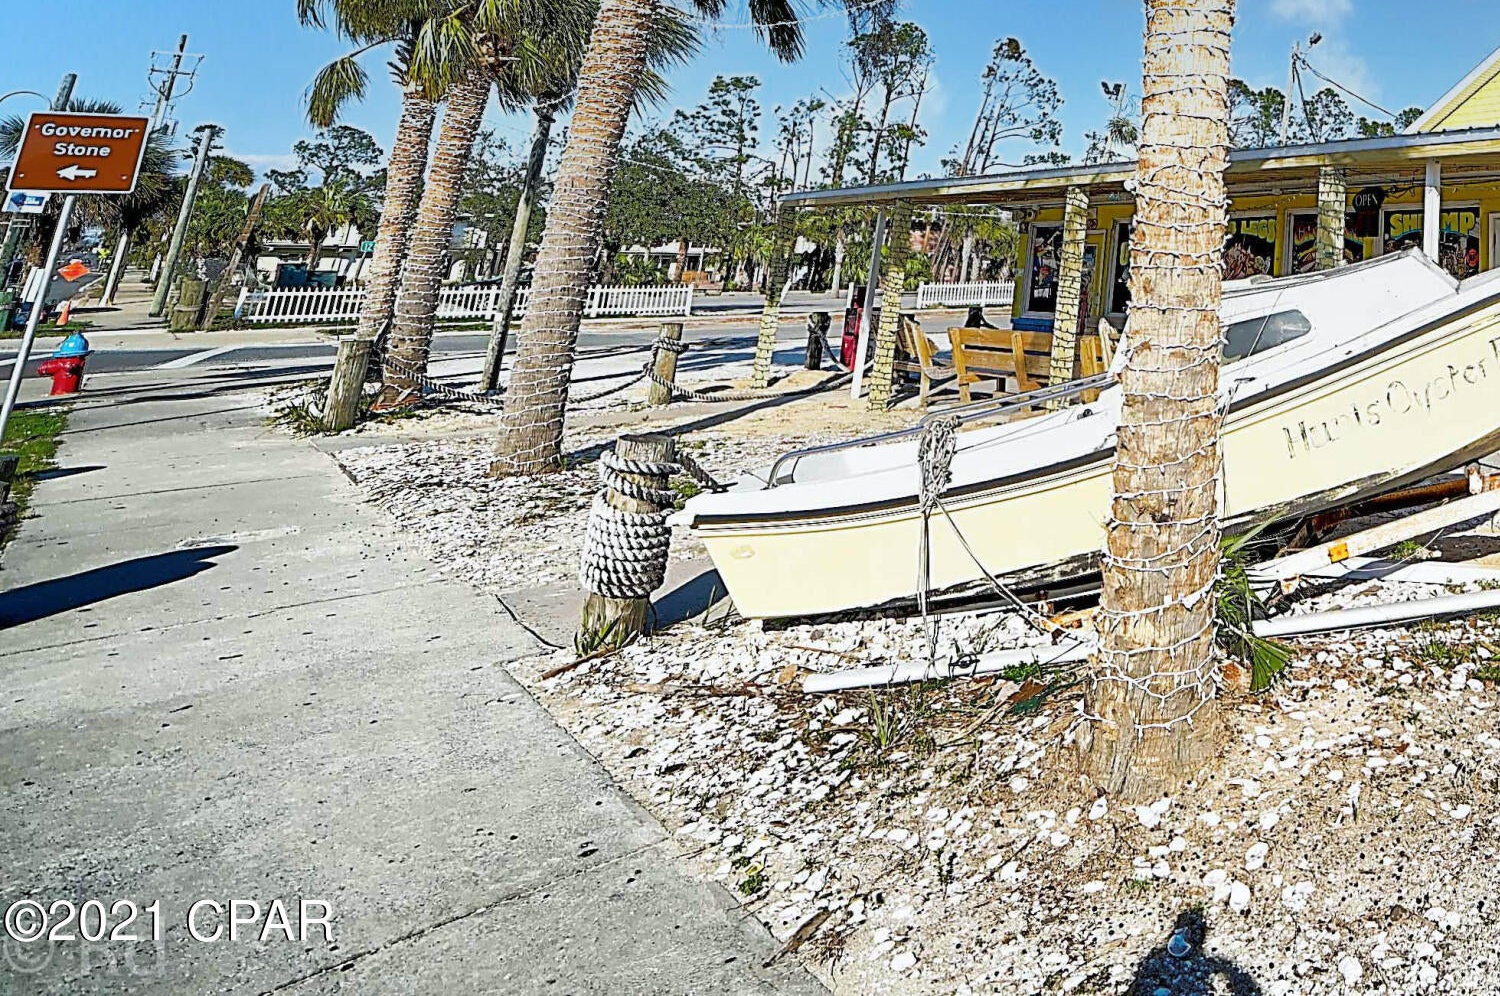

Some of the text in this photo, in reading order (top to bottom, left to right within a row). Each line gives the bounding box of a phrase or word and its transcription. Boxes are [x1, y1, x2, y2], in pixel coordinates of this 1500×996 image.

[41, 123, 133, 139] Governor
[53, 142, 111, 157] Stone
[1355, 192, 1379, 207] OPEN
[1389, 211, 1476, 239] SHMP
